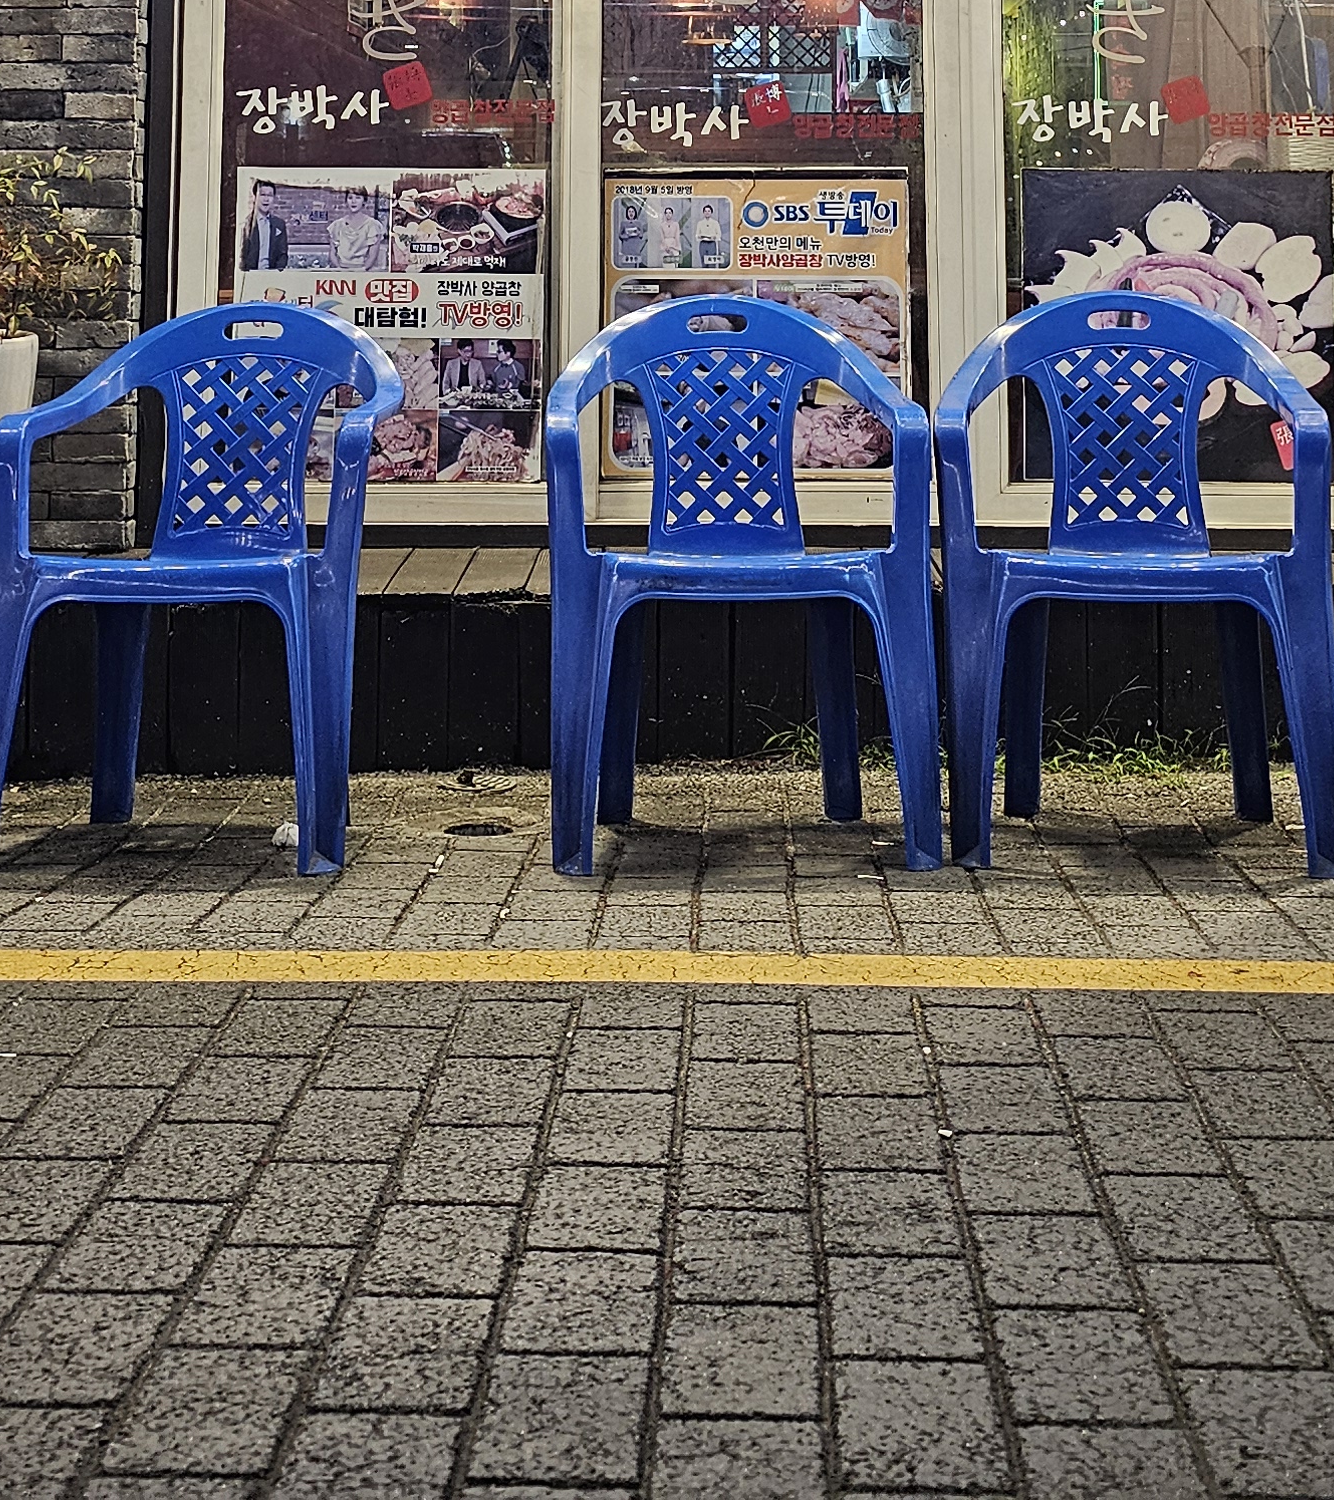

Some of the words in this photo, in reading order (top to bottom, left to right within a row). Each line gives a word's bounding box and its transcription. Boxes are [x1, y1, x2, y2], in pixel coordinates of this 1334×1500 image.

[237, 83, 391, 134] 장박사
[1012, 94, 1169, 143] 장박사
[602, 99, 749, 148] 장박사
[774, 205, 809, 222] SBS
[814, 200, 898, 235] 투데이
[870, 226, 894, 235] Today
[739, 236, 791, 250] 오천만의
[796, 237, 822, 250] 메뉴
[738, 253, 823, 268] 장박사양곱창
[827, 253, 876, 268] TV방영!
[316, 279, 357, 296] KNN
[369, 279, 413, 303] 맛집
[437, 280, 478, 297] 장박사
[482, 280, 522, 298] 양곱창
[355, 307, 427, 329] 대탐험!
[437, 300, 523, 328] TV방영!
